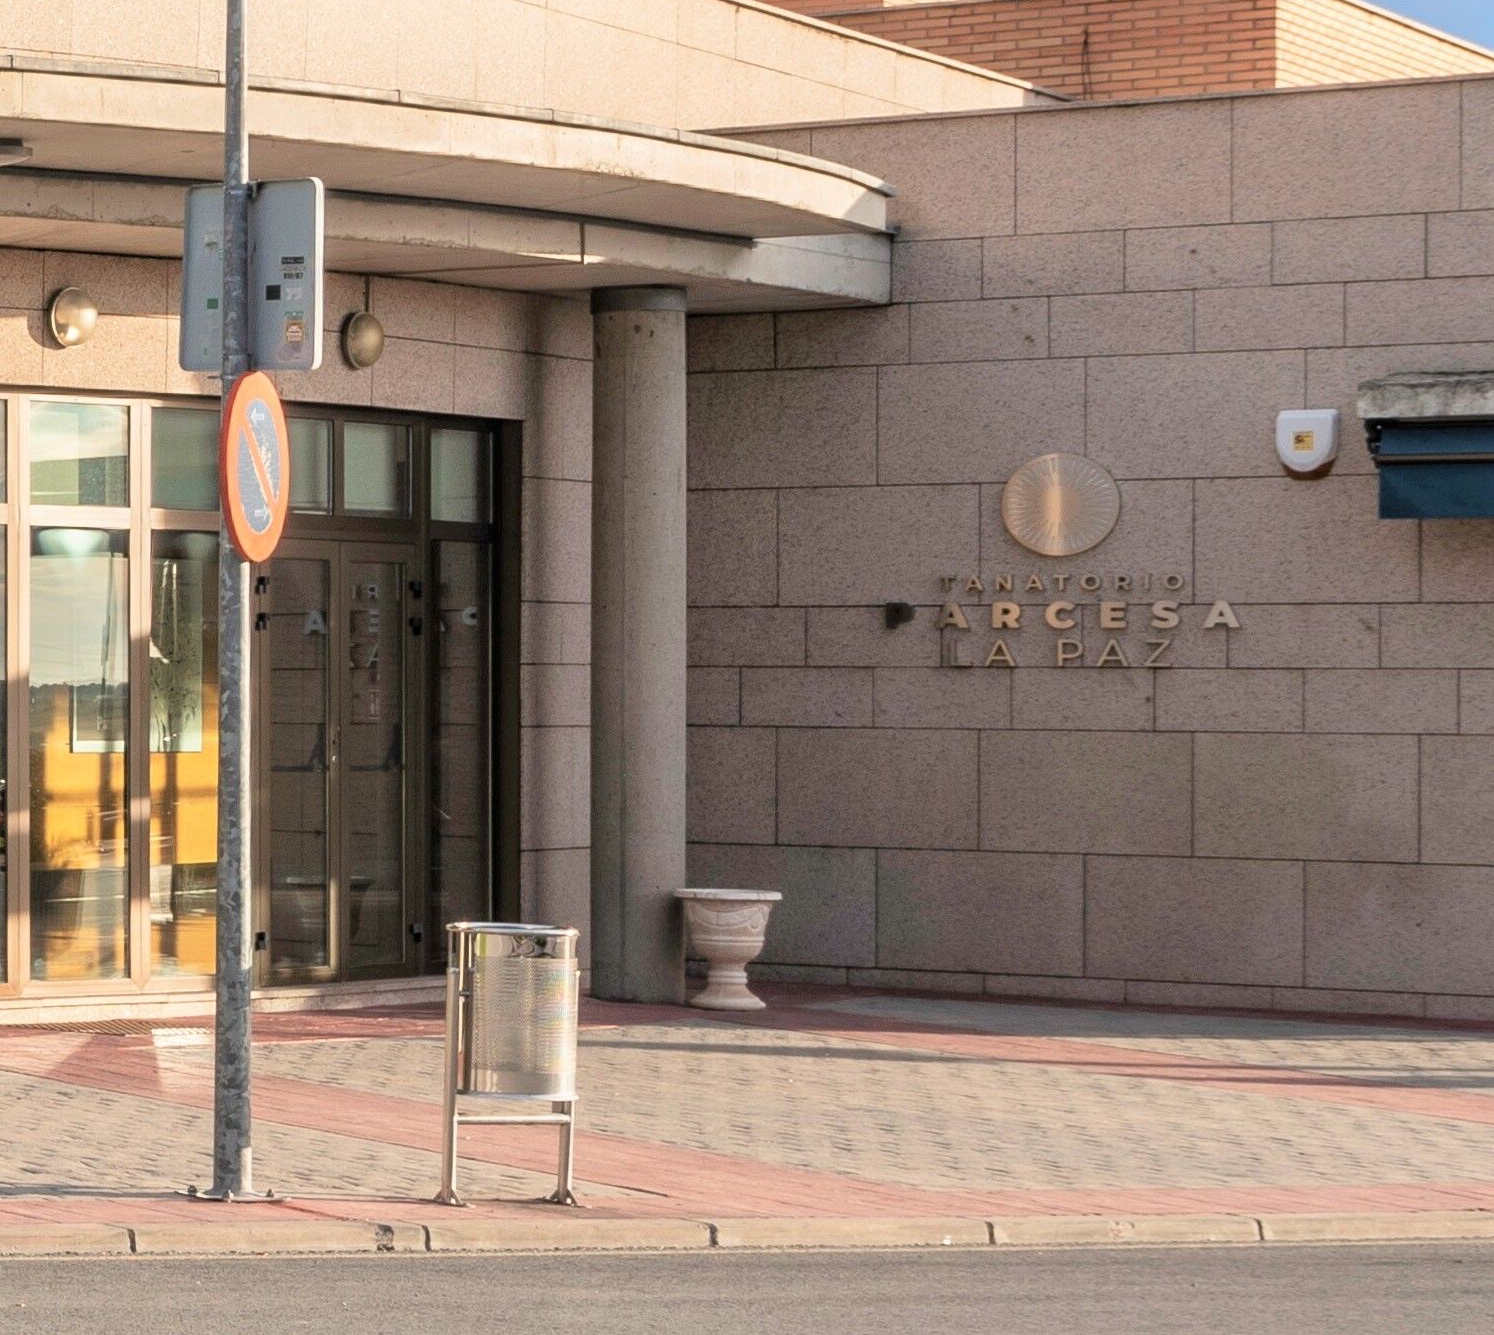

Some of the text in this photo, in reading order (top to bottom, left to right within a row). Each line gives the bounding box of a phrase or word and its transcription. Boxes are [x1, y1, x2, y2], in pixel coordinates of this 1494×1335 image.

[940, 573, 1185, 593] TANATORIO
[944, 638, 1174, 667] LA PAZ
